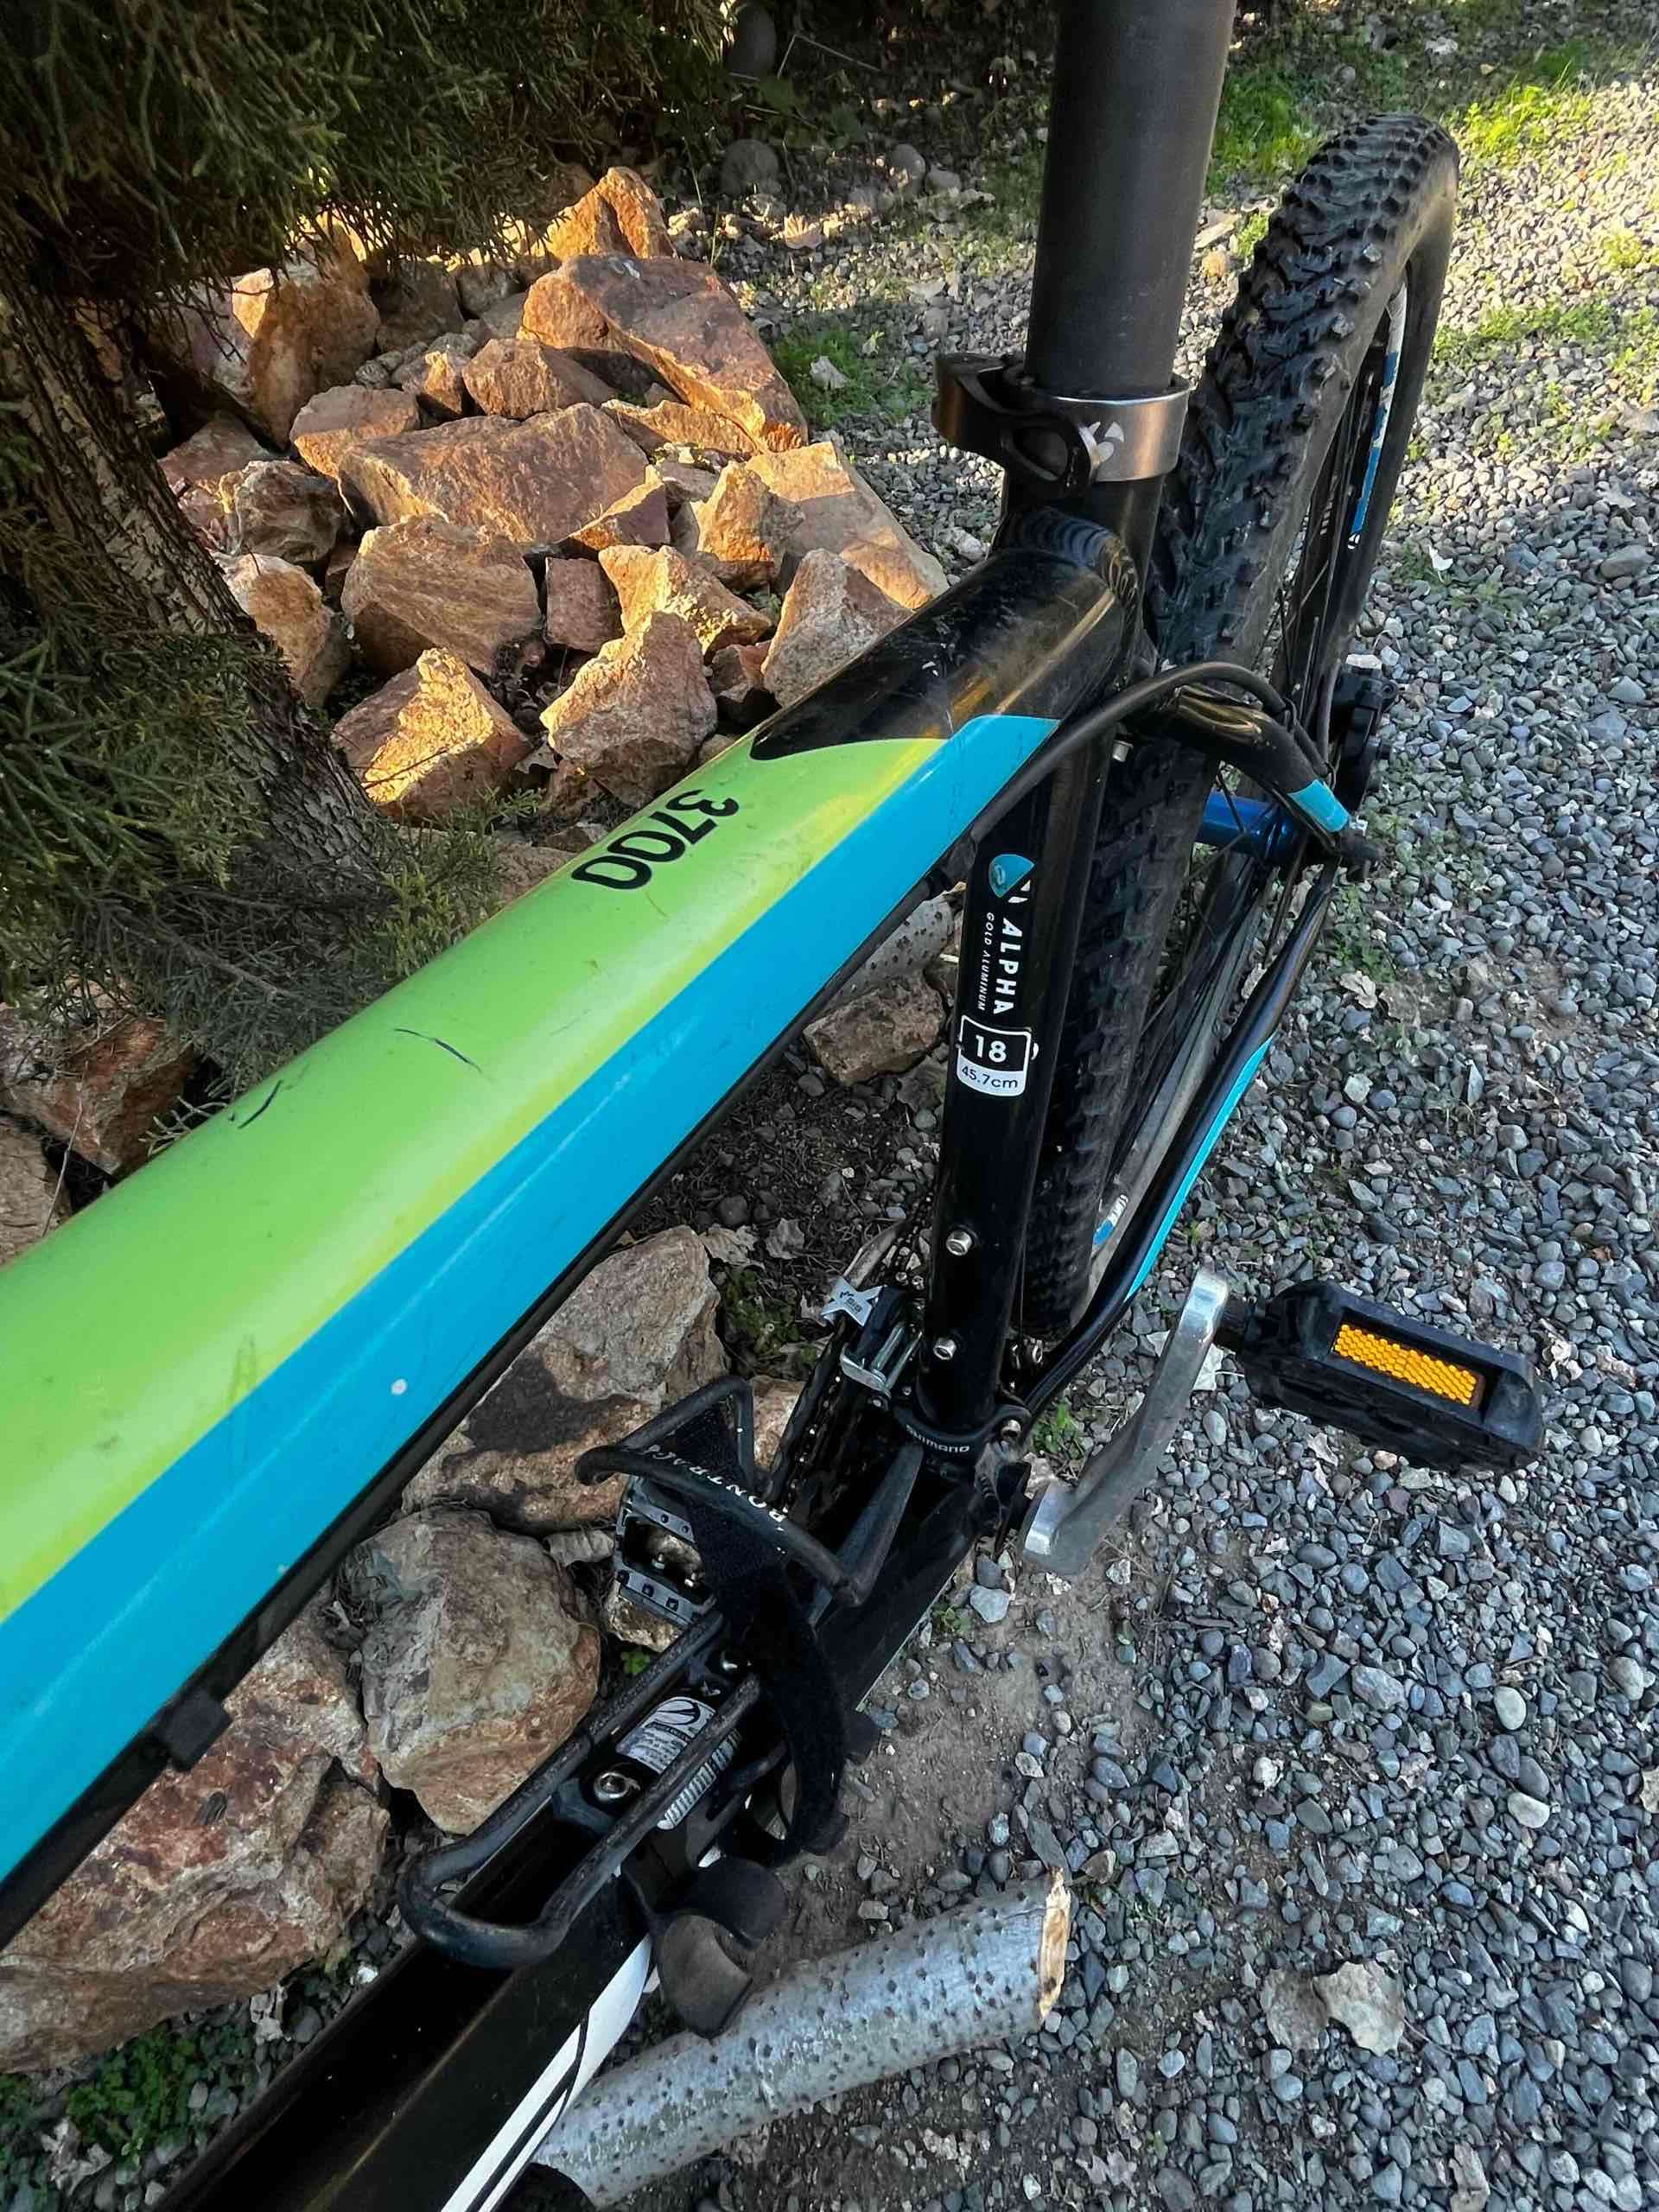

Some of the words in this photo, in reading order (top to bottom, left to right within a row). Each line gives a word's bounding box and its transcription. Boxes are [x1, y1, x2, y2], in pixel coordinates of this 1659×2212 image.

[570, 789, 740, 890] 3700
[984, 912, 995, 945] GOLD
[977, 950, 991, 1011] ALUMINUM
[993, 917, 1023, 1014] ALPHA
[975, 1034, 1007, 1064] 18
[961, 1065, 1019, 1089] 45.7cm
